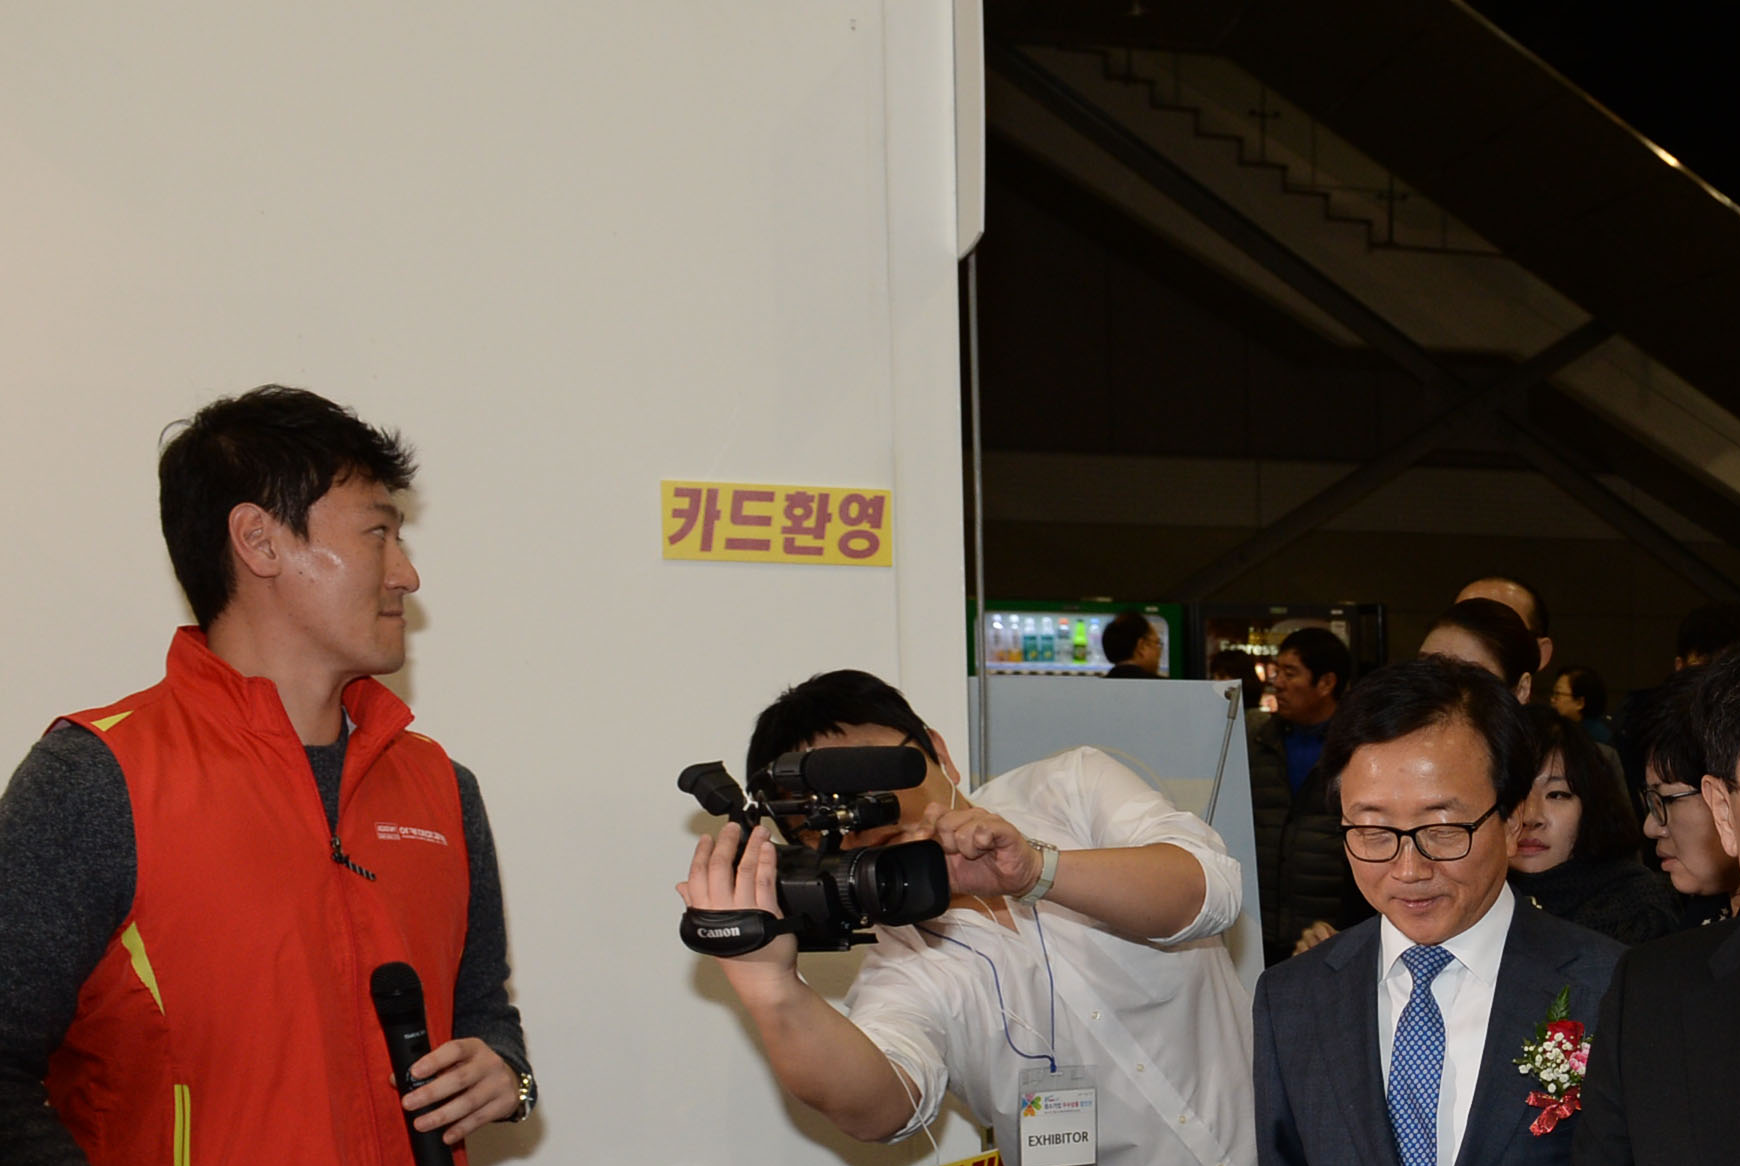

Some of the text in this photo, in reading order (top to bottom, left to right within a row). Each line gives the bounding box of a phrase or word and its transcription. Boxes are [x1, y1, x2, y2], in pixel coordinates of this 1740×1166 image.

[668, 487, 885, 559] 카드환영
[697, 927, 741, 938] Canon
[1028, 1131, 1089, 1147] EXHIBITOR
